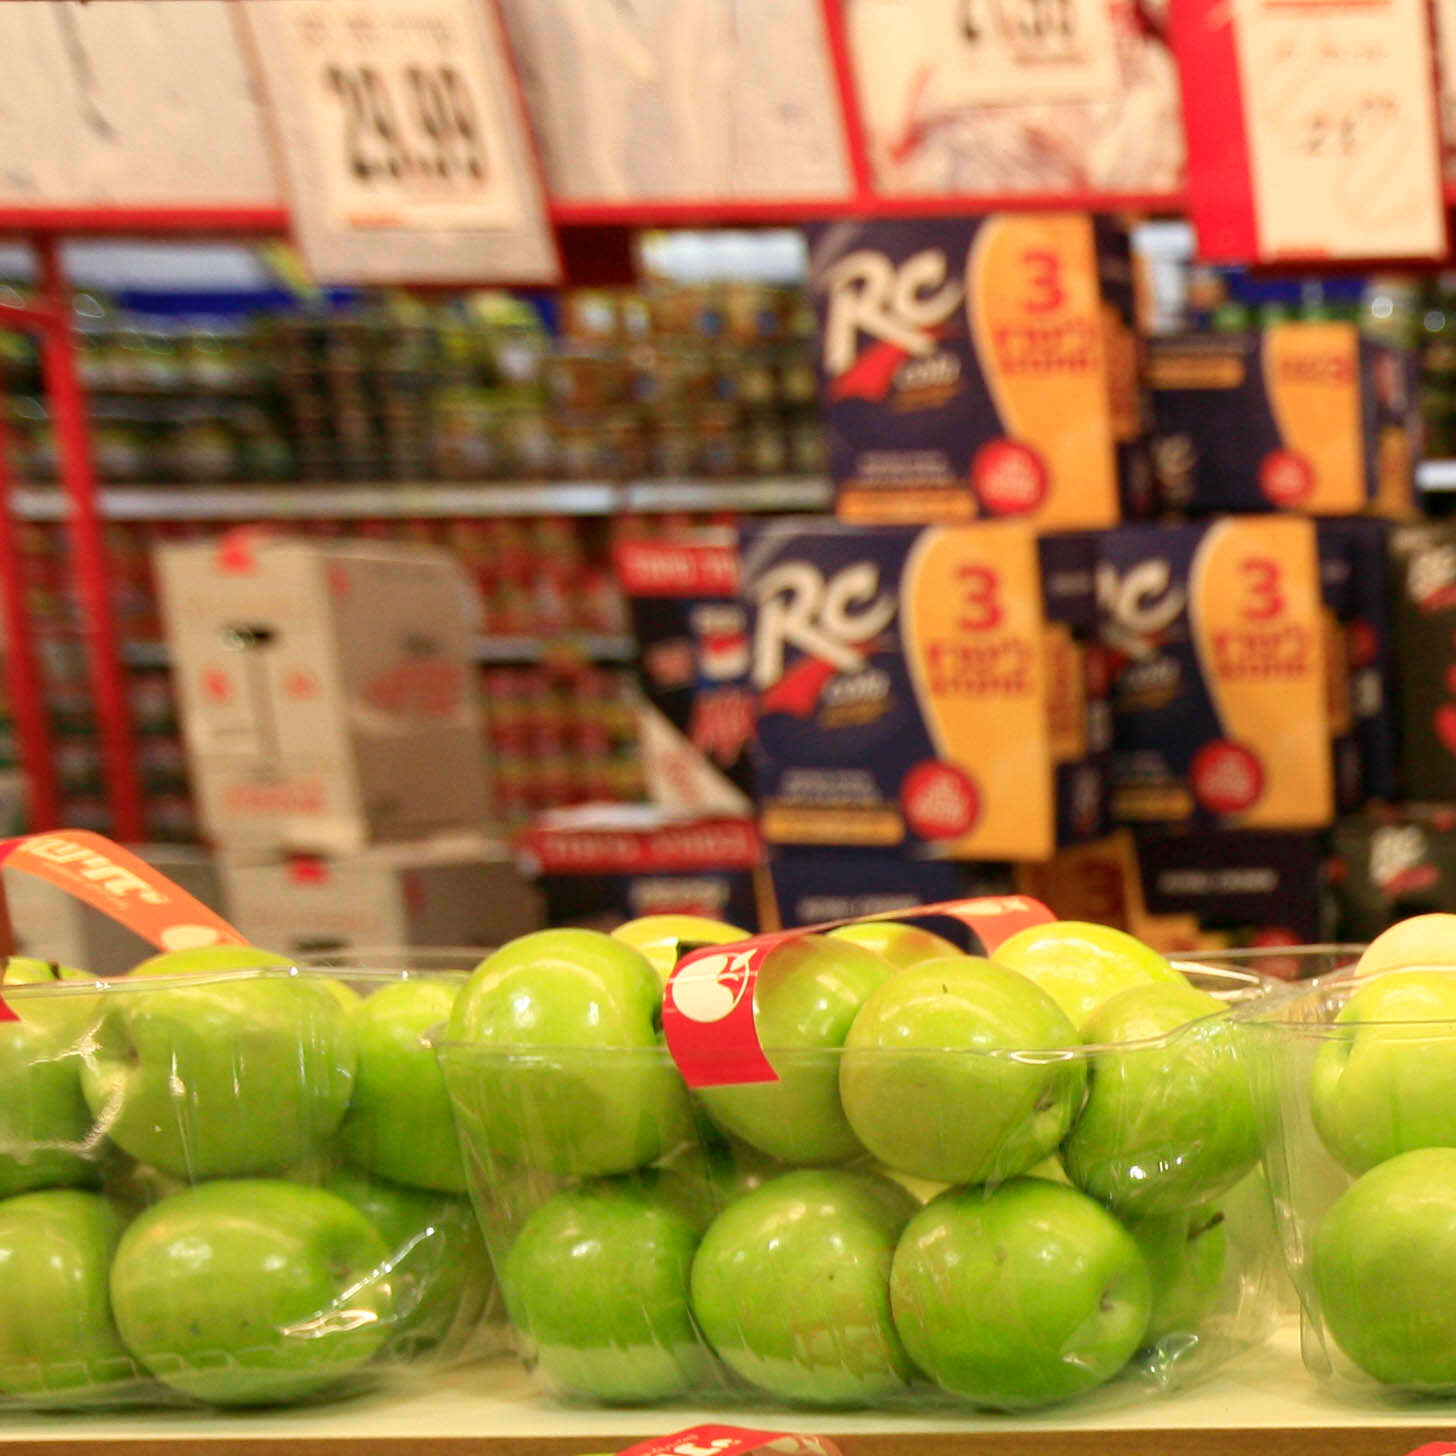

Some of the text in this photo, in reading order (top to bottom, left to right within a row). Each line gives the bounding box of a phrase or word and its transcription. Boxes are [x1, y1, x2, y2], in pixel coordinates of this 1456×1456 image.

[822, 248, 965, 376] RC
[1022, 250, 1064, 314] 3
[956, 564, 1004, 632] 3
[1239, 557, 1284, 621] 3
[751, 561, 898, 692] RC
